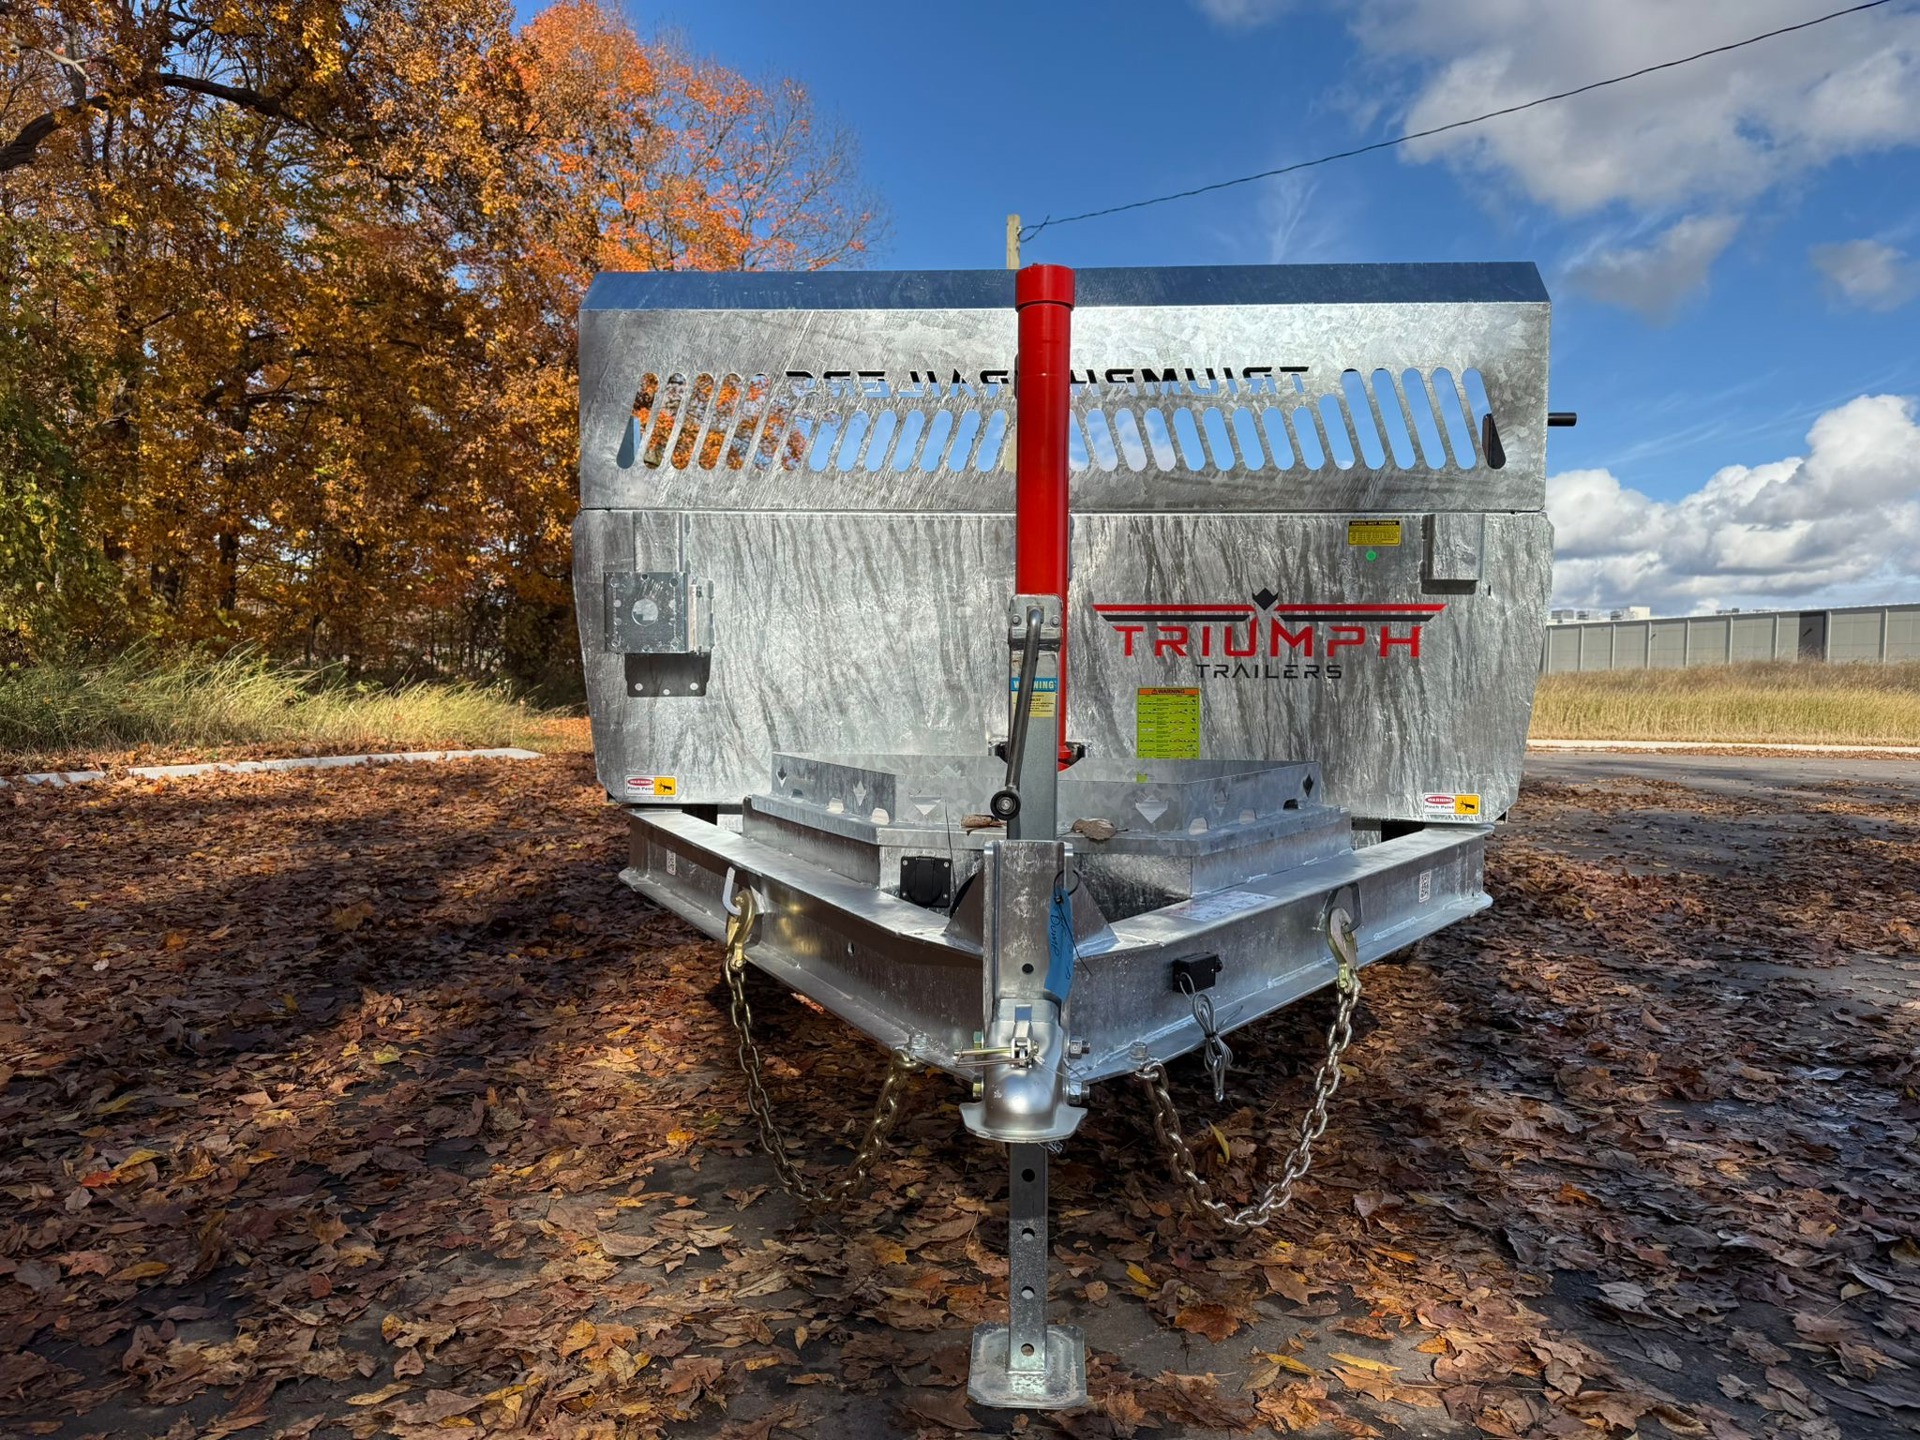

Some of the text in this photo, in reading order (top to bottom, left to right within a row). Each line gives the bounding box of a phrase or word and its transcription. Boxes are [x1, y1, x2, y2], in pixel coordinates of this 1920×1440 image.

[1112, 616, 1423, 657] TRIUMPH
[1197, 664, 1342, 679] TRAILERS
[1012, 680, 1055, 690] WNING
